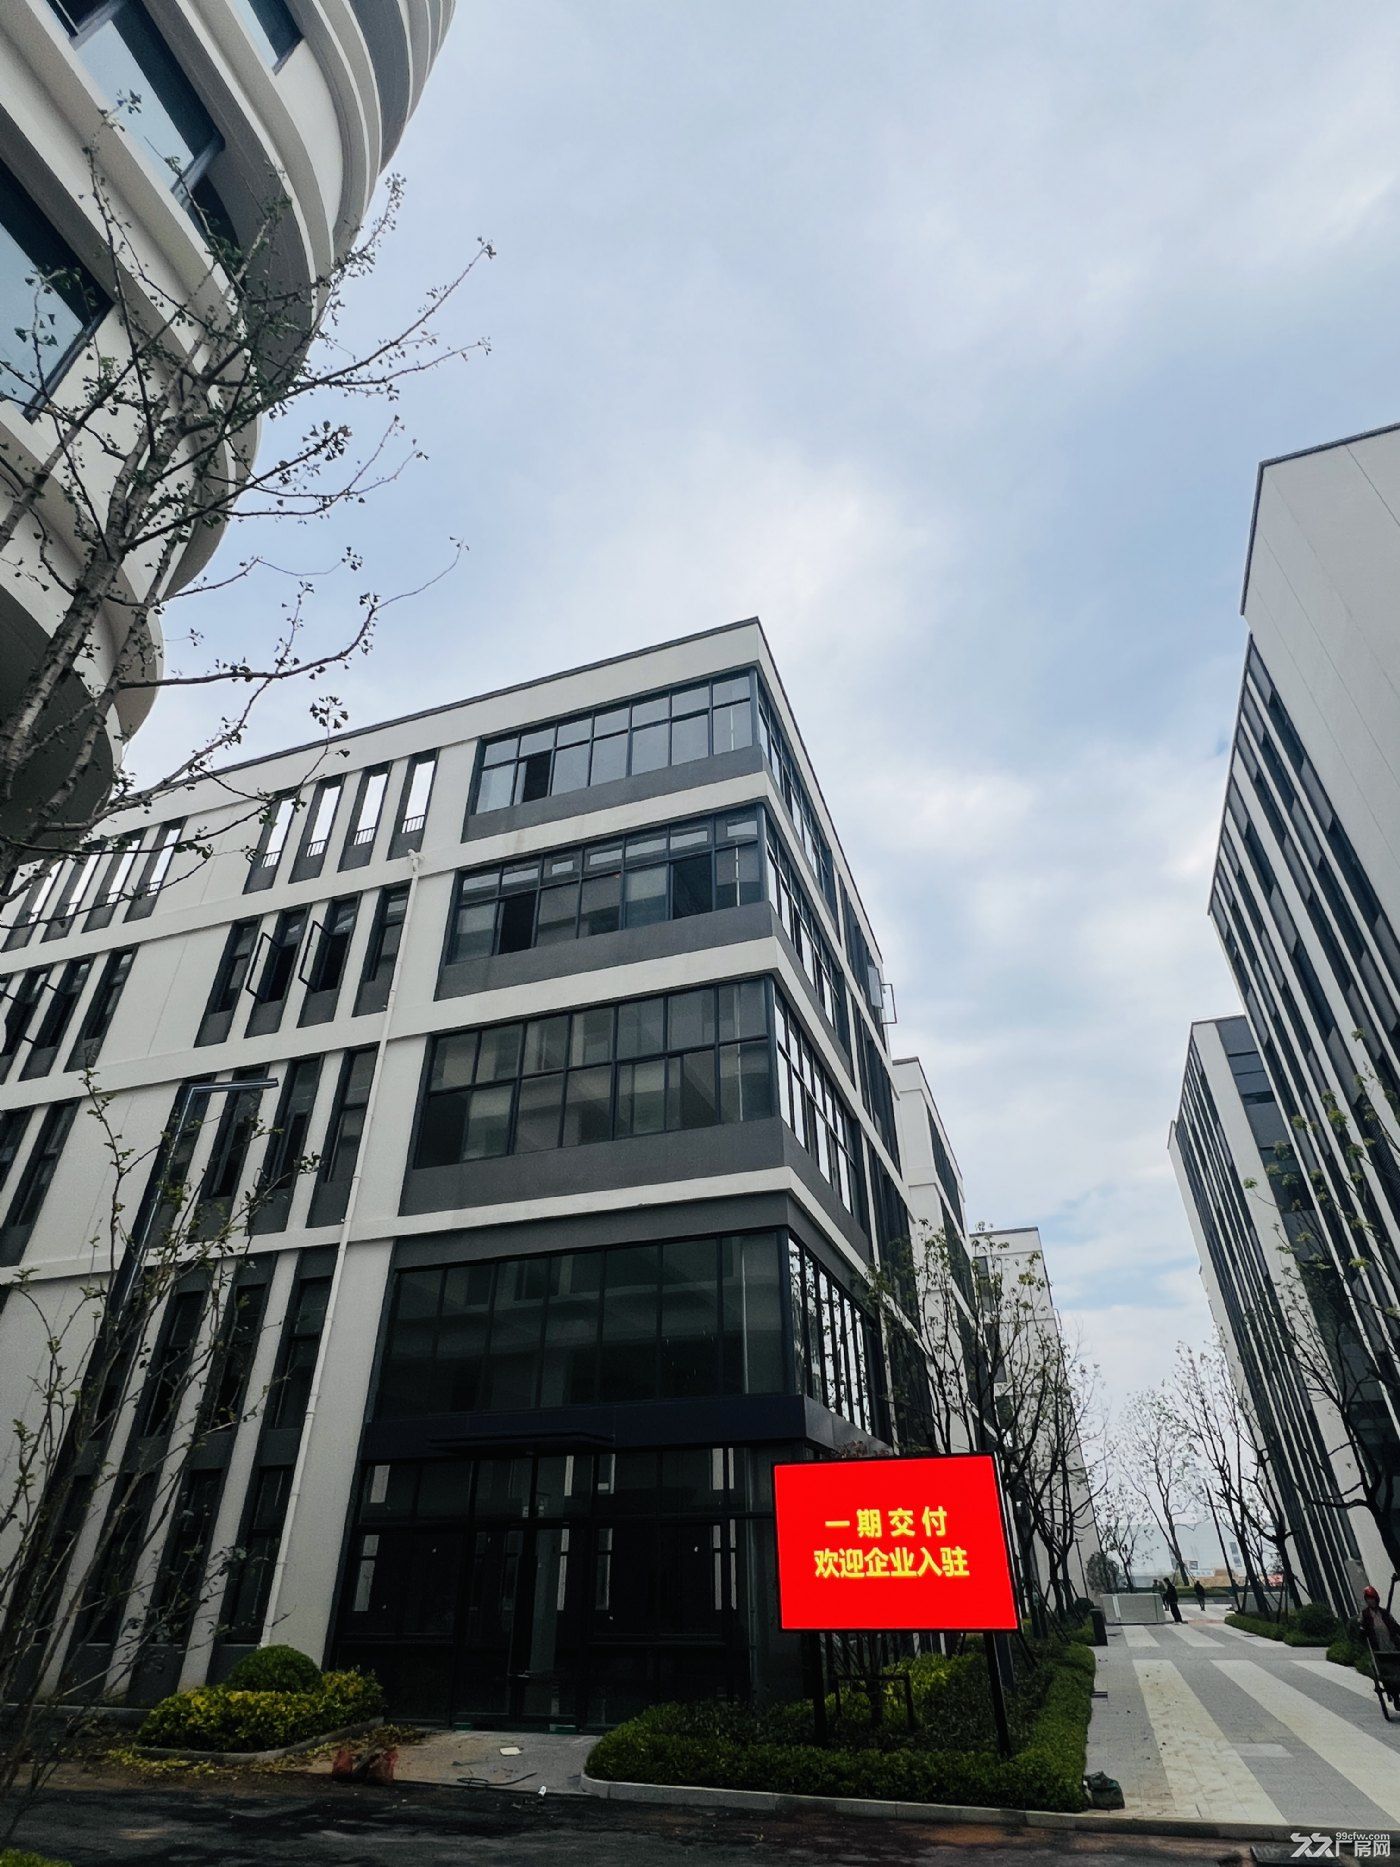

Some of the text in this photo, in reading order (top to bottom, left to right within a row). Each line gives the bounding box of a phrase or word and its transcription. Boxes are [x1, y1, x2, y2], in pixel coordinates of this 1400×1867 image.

[825, 1506, 948, 1537] 一期交付
[813, 1546, 970, 1578] 欢迎企业入驻
